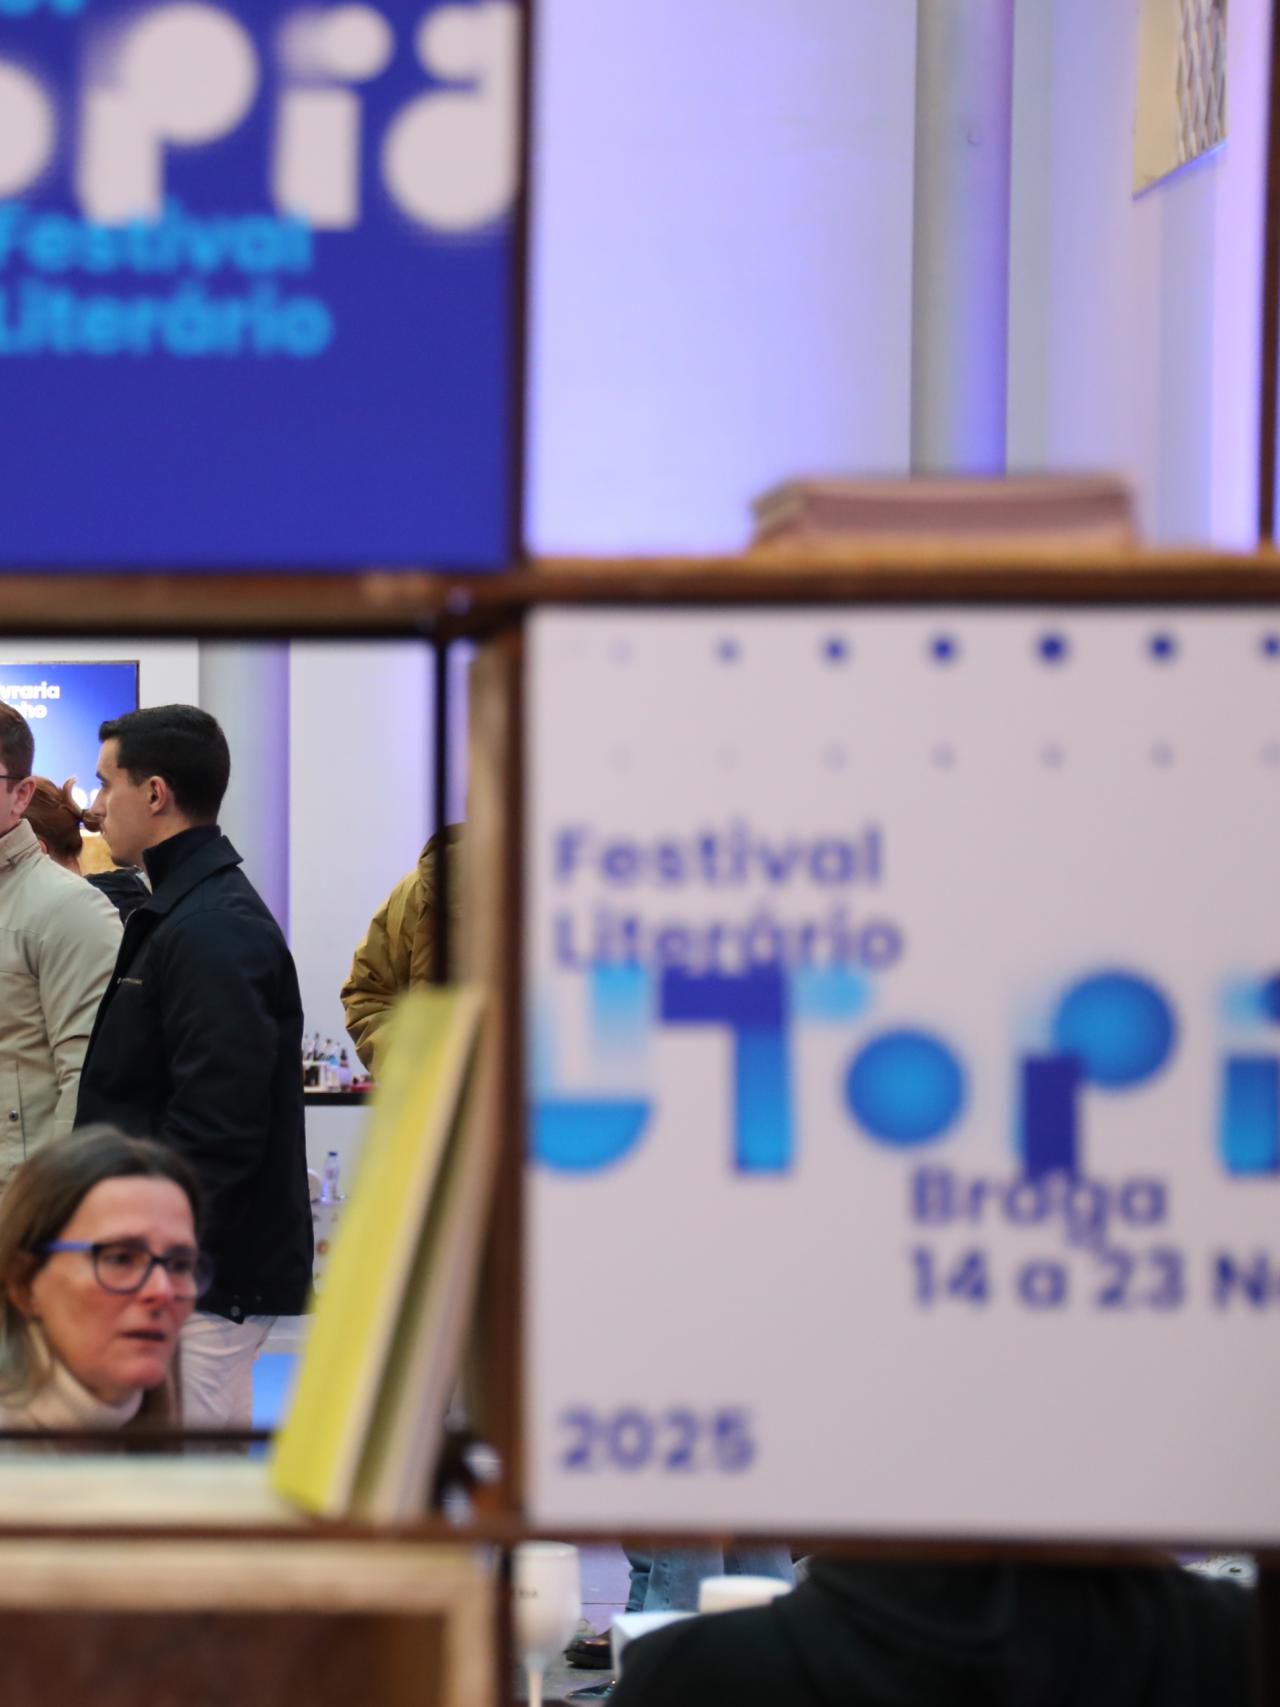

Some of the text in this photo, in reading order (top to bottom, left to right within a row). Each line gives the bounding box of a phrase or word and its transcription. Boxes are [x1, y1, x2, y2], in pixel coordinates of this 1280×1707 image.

[554, 821, 886, 888] Festival
[554, 906, 907, 971] Literário
[910, 1165, 1169, 1252] Braga
[910, 1246, 990, 1311] 14
[1018, 1260, 1070, 1310] a
[1093, 1247, 1187, 1311] 23
[560, 1407, 757, 1474] 2025
